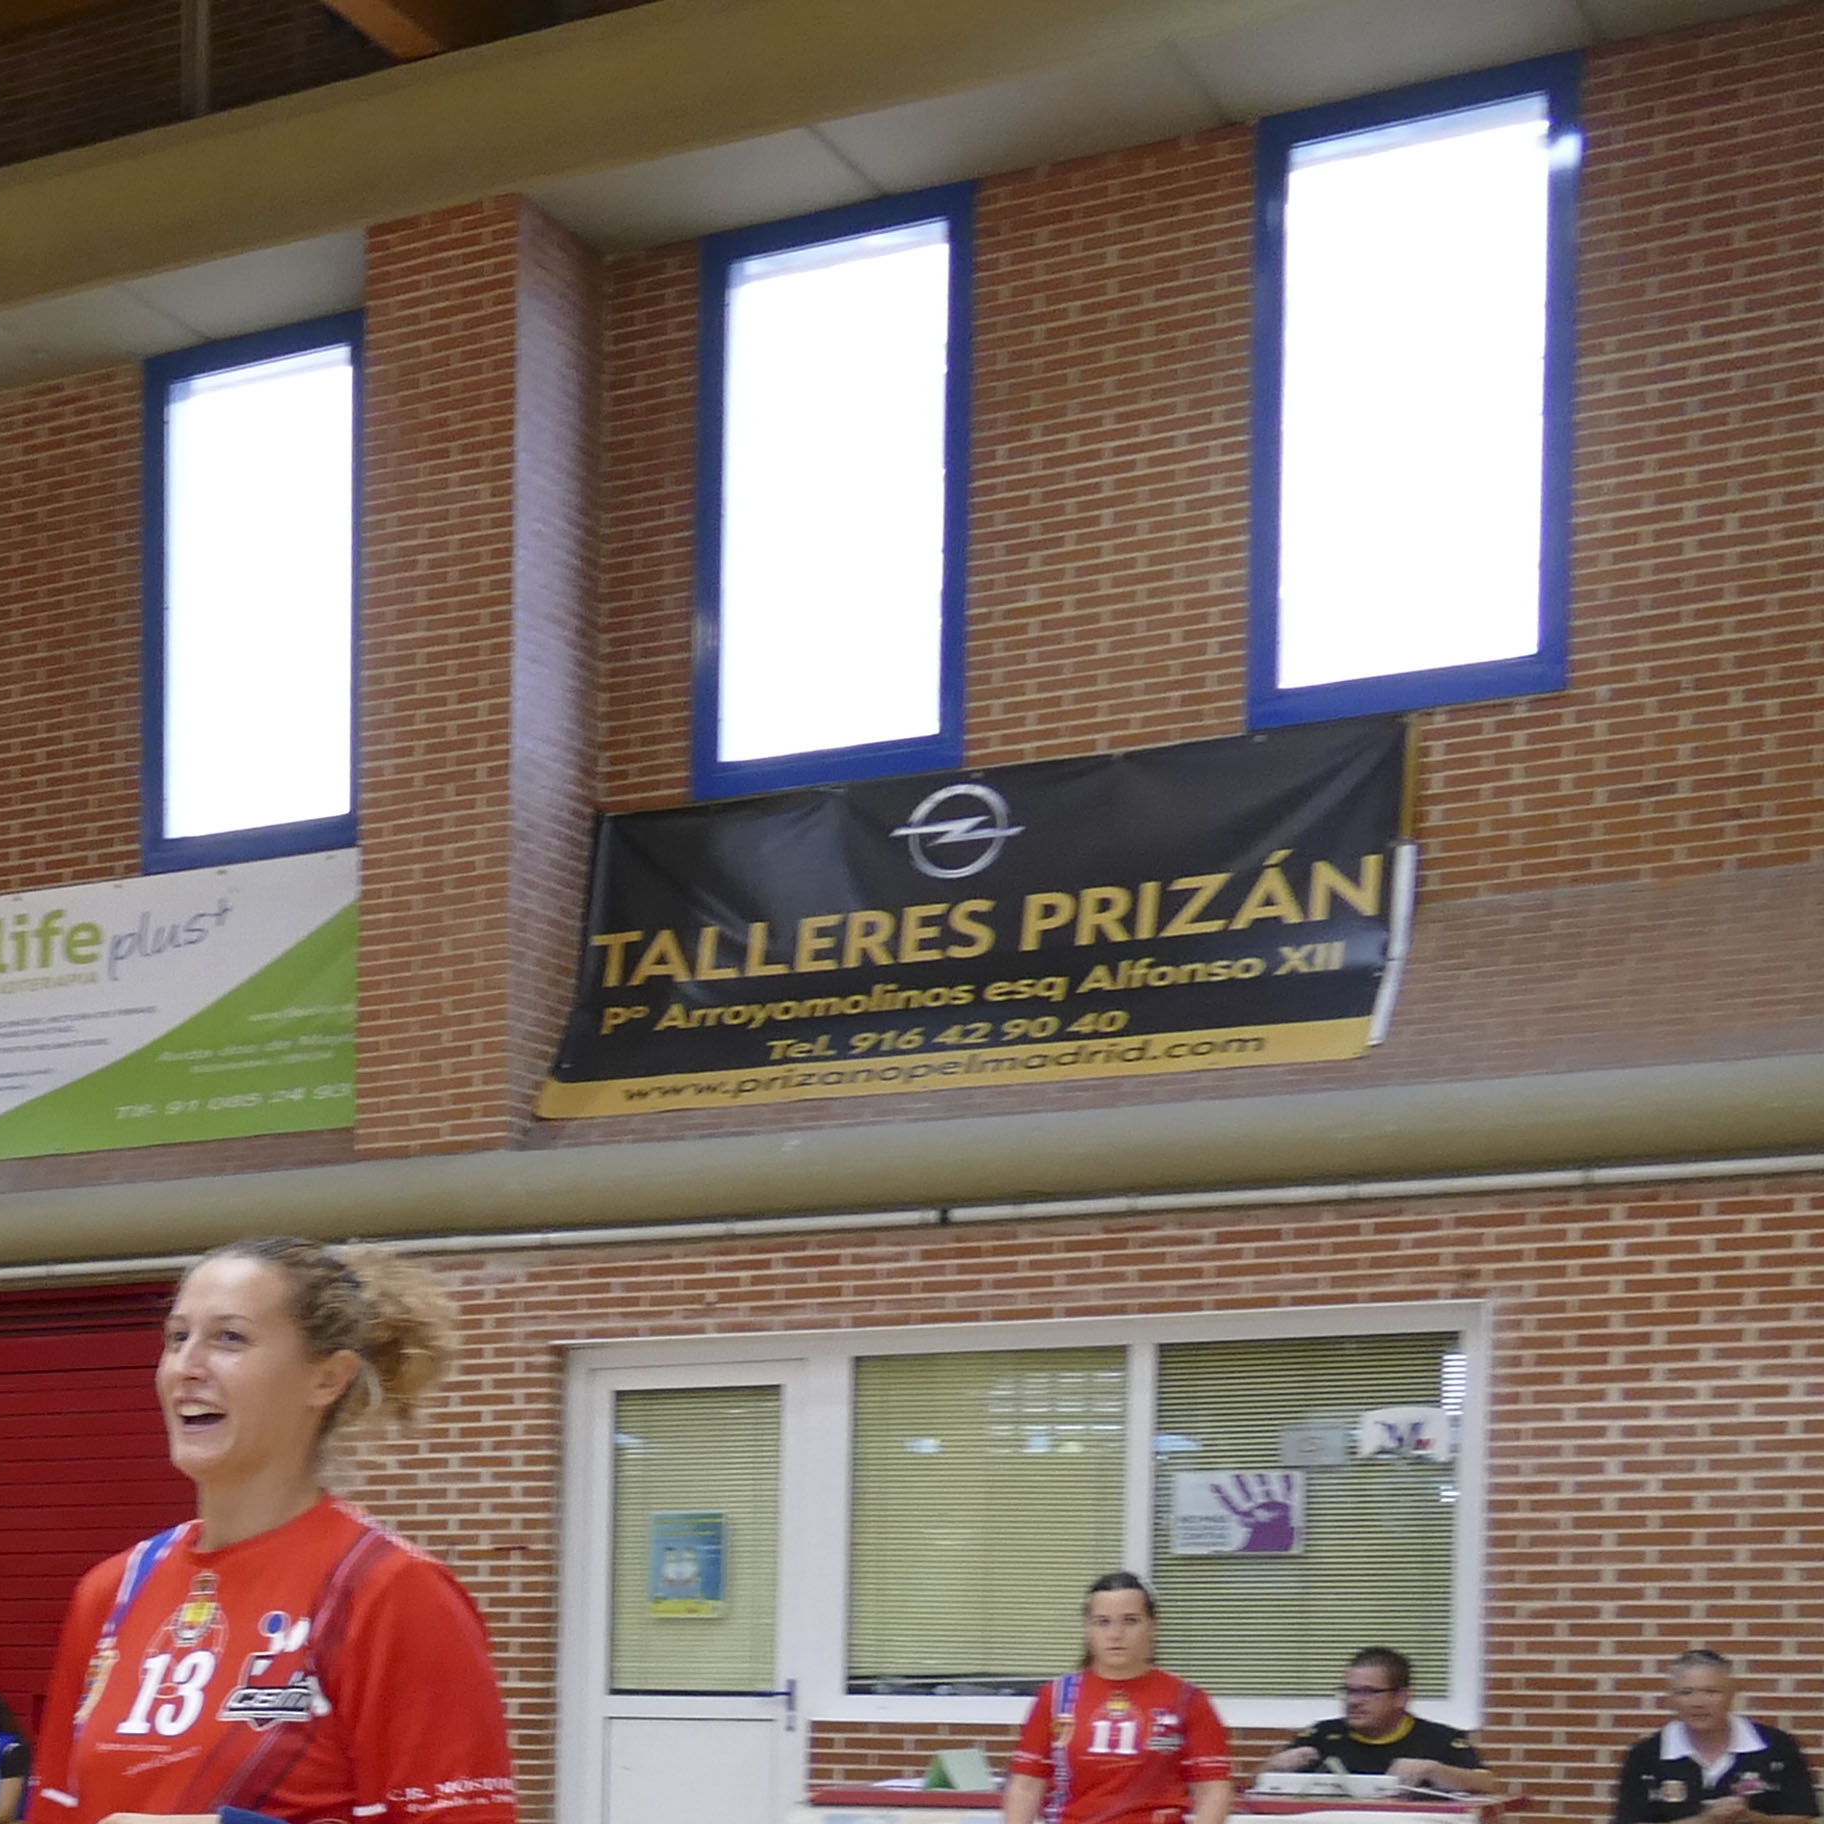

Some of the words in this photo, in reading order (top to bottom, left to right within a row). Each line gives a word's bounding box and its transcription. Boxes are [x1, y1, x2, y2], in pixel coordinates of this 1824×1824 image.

[592, 898, 996, 988] TALLERES
[1018, 848, 1385, 951] PRIZÁN
[653, 982, 976, 1030] Arroyomolinos
[984, 973, 1072, 1003] esq
[1075, 954, 1267, 994] Alfonso
[623, 1033, 1267, 1102] www.prizanopelmadrid.com
[847, 1026, 928, 1055] 916
[932, 1021, 994, 1046] 42
[1000, 1015, 1063, 1042] 90
[1066, 1010, 1131, 1035] 40
[115, 1650, 218, 1737] 13
[1087, 1719, 1142, 1755] 11
